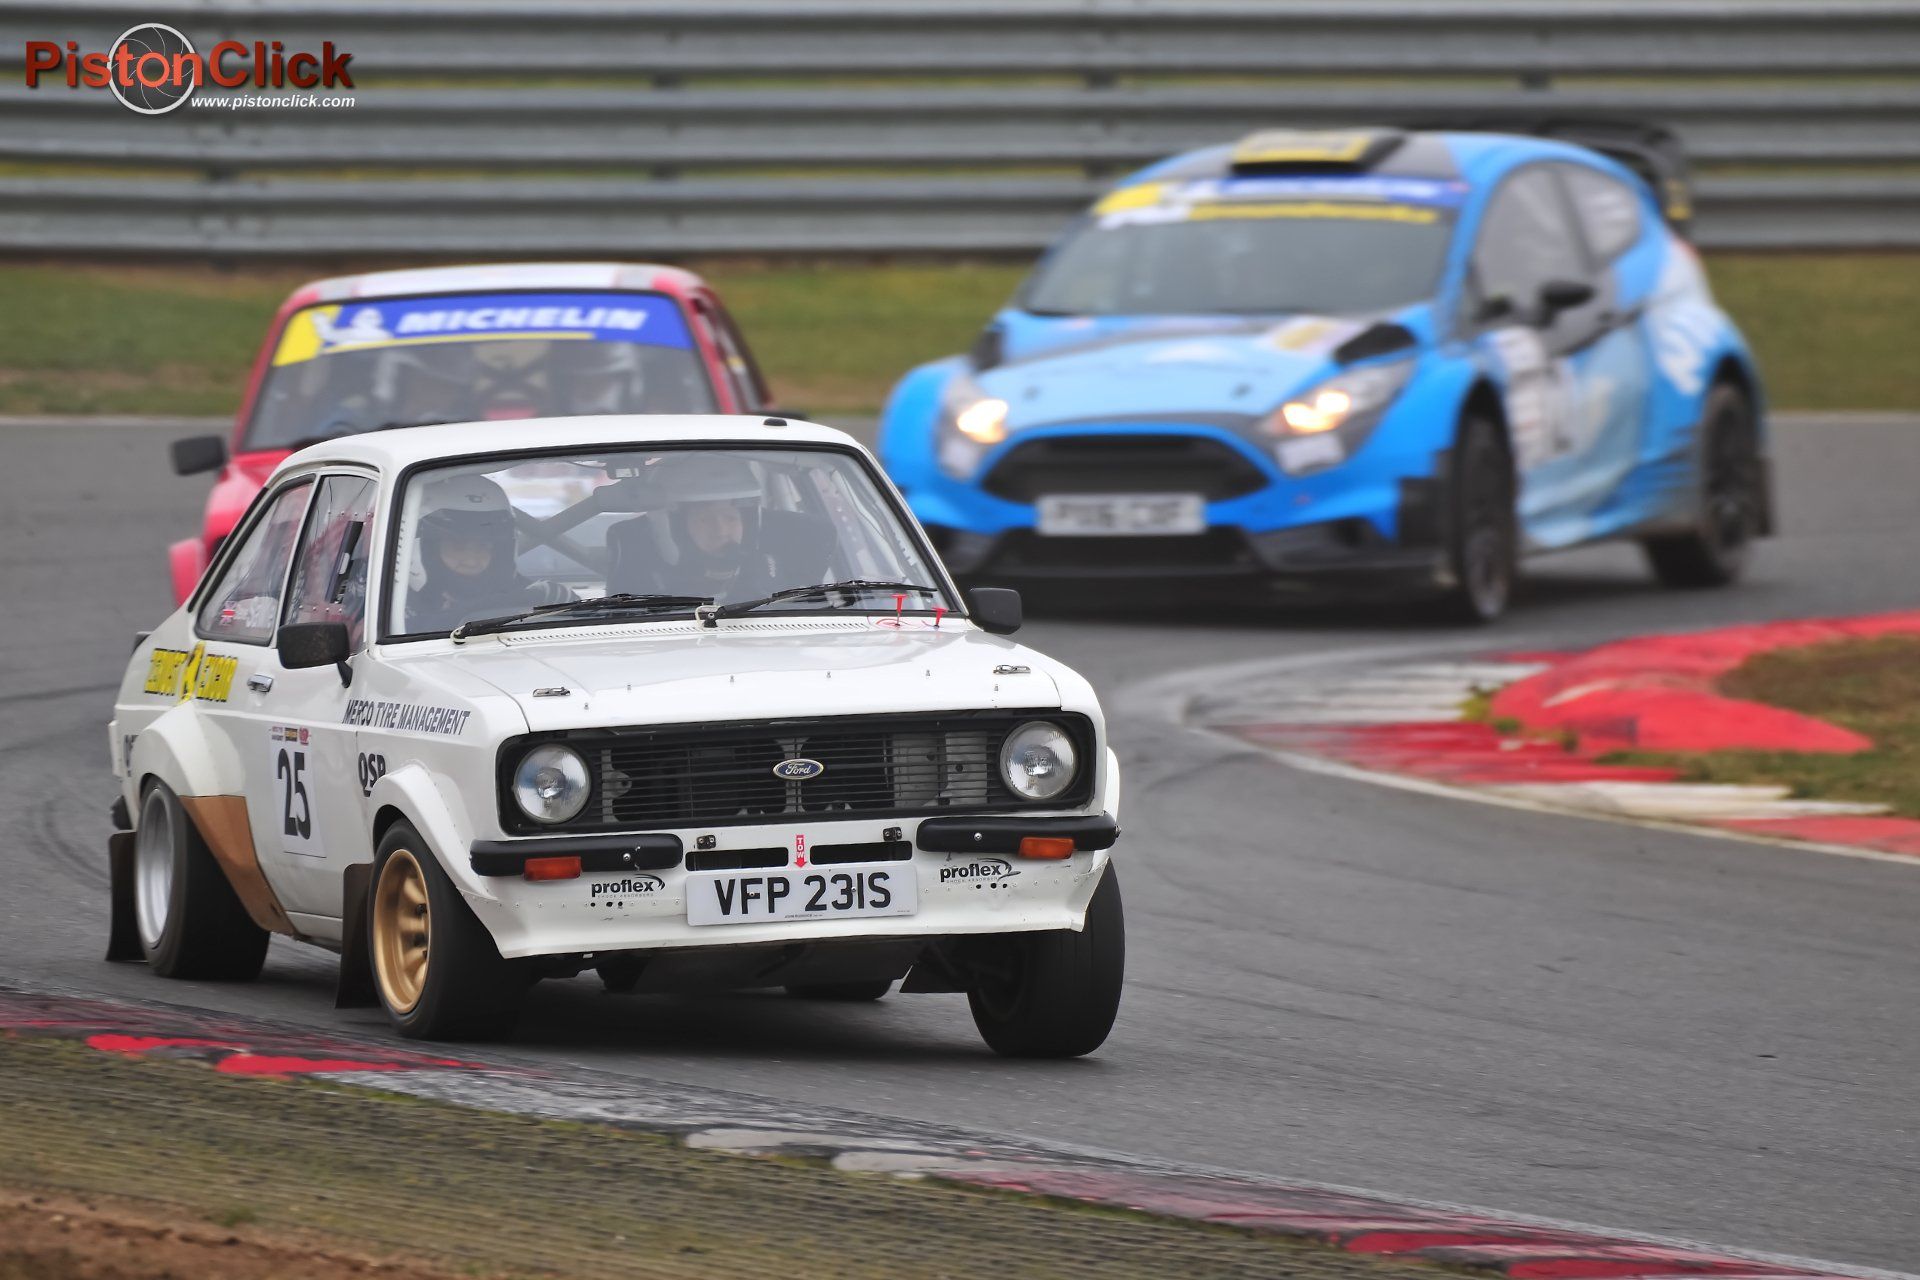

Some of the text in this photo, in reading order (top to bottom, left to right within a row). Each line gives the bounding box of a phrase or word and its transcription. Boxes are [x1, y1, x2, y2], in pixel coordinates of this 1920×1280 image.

[397, 307, 649, 333] MICHELIN
[374, 701, 401, 729] TYRE
[396, 704, 471, 735] MANAGEMENT
[785, 762, 811, 775] Ford
[277, 748, 311, 840] 25
[796, 837, 804, 859] TOW
[940, 863, 1002, 883] proflex
[591, 879, 654, 898] proflex
[714, 876, 791, 916] VFP
